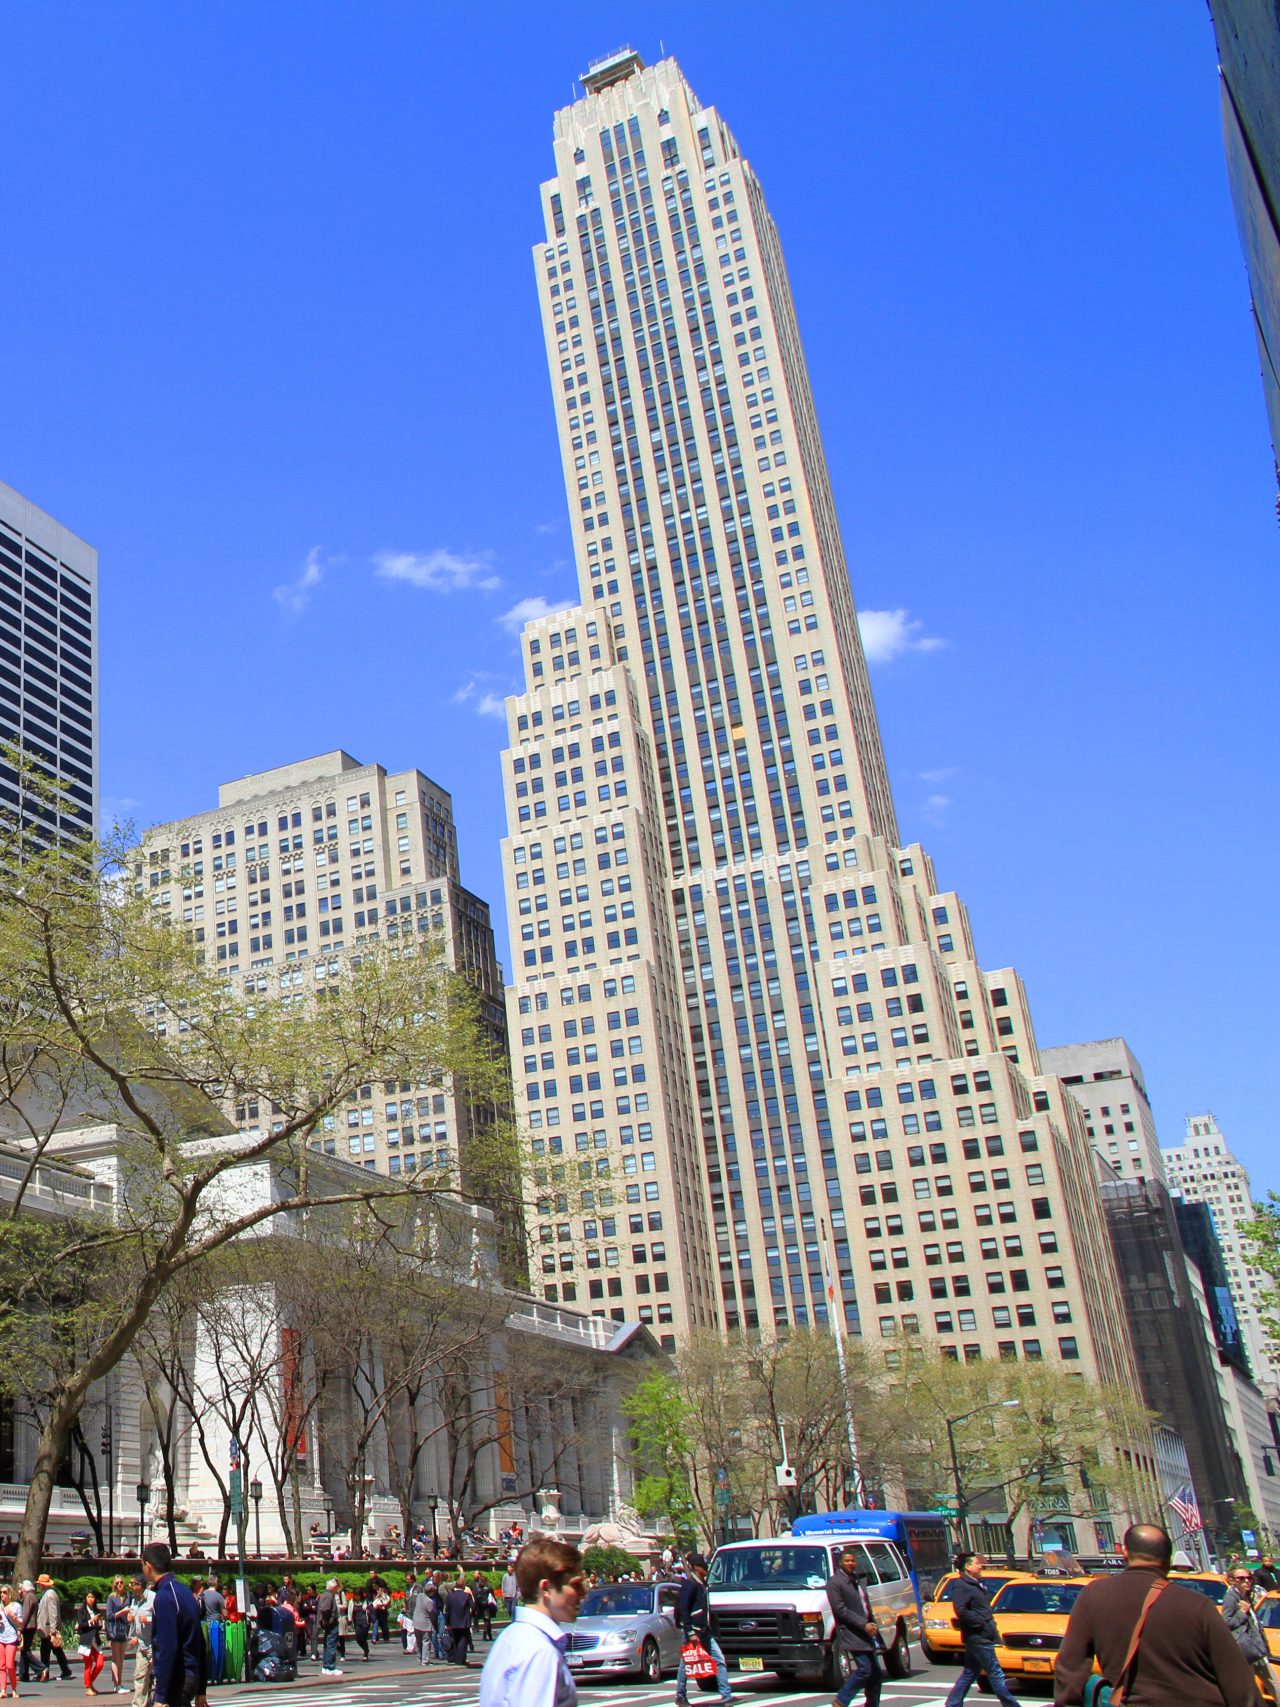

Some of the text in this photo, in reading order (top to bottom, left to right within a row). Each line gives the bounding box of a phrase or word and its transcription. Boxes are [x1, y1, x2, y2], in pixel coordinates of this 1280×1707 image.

[805, 1527, 880, 1536] Memorial Sloan-Kettering
[684, 1662, 713, 1675] SALE
